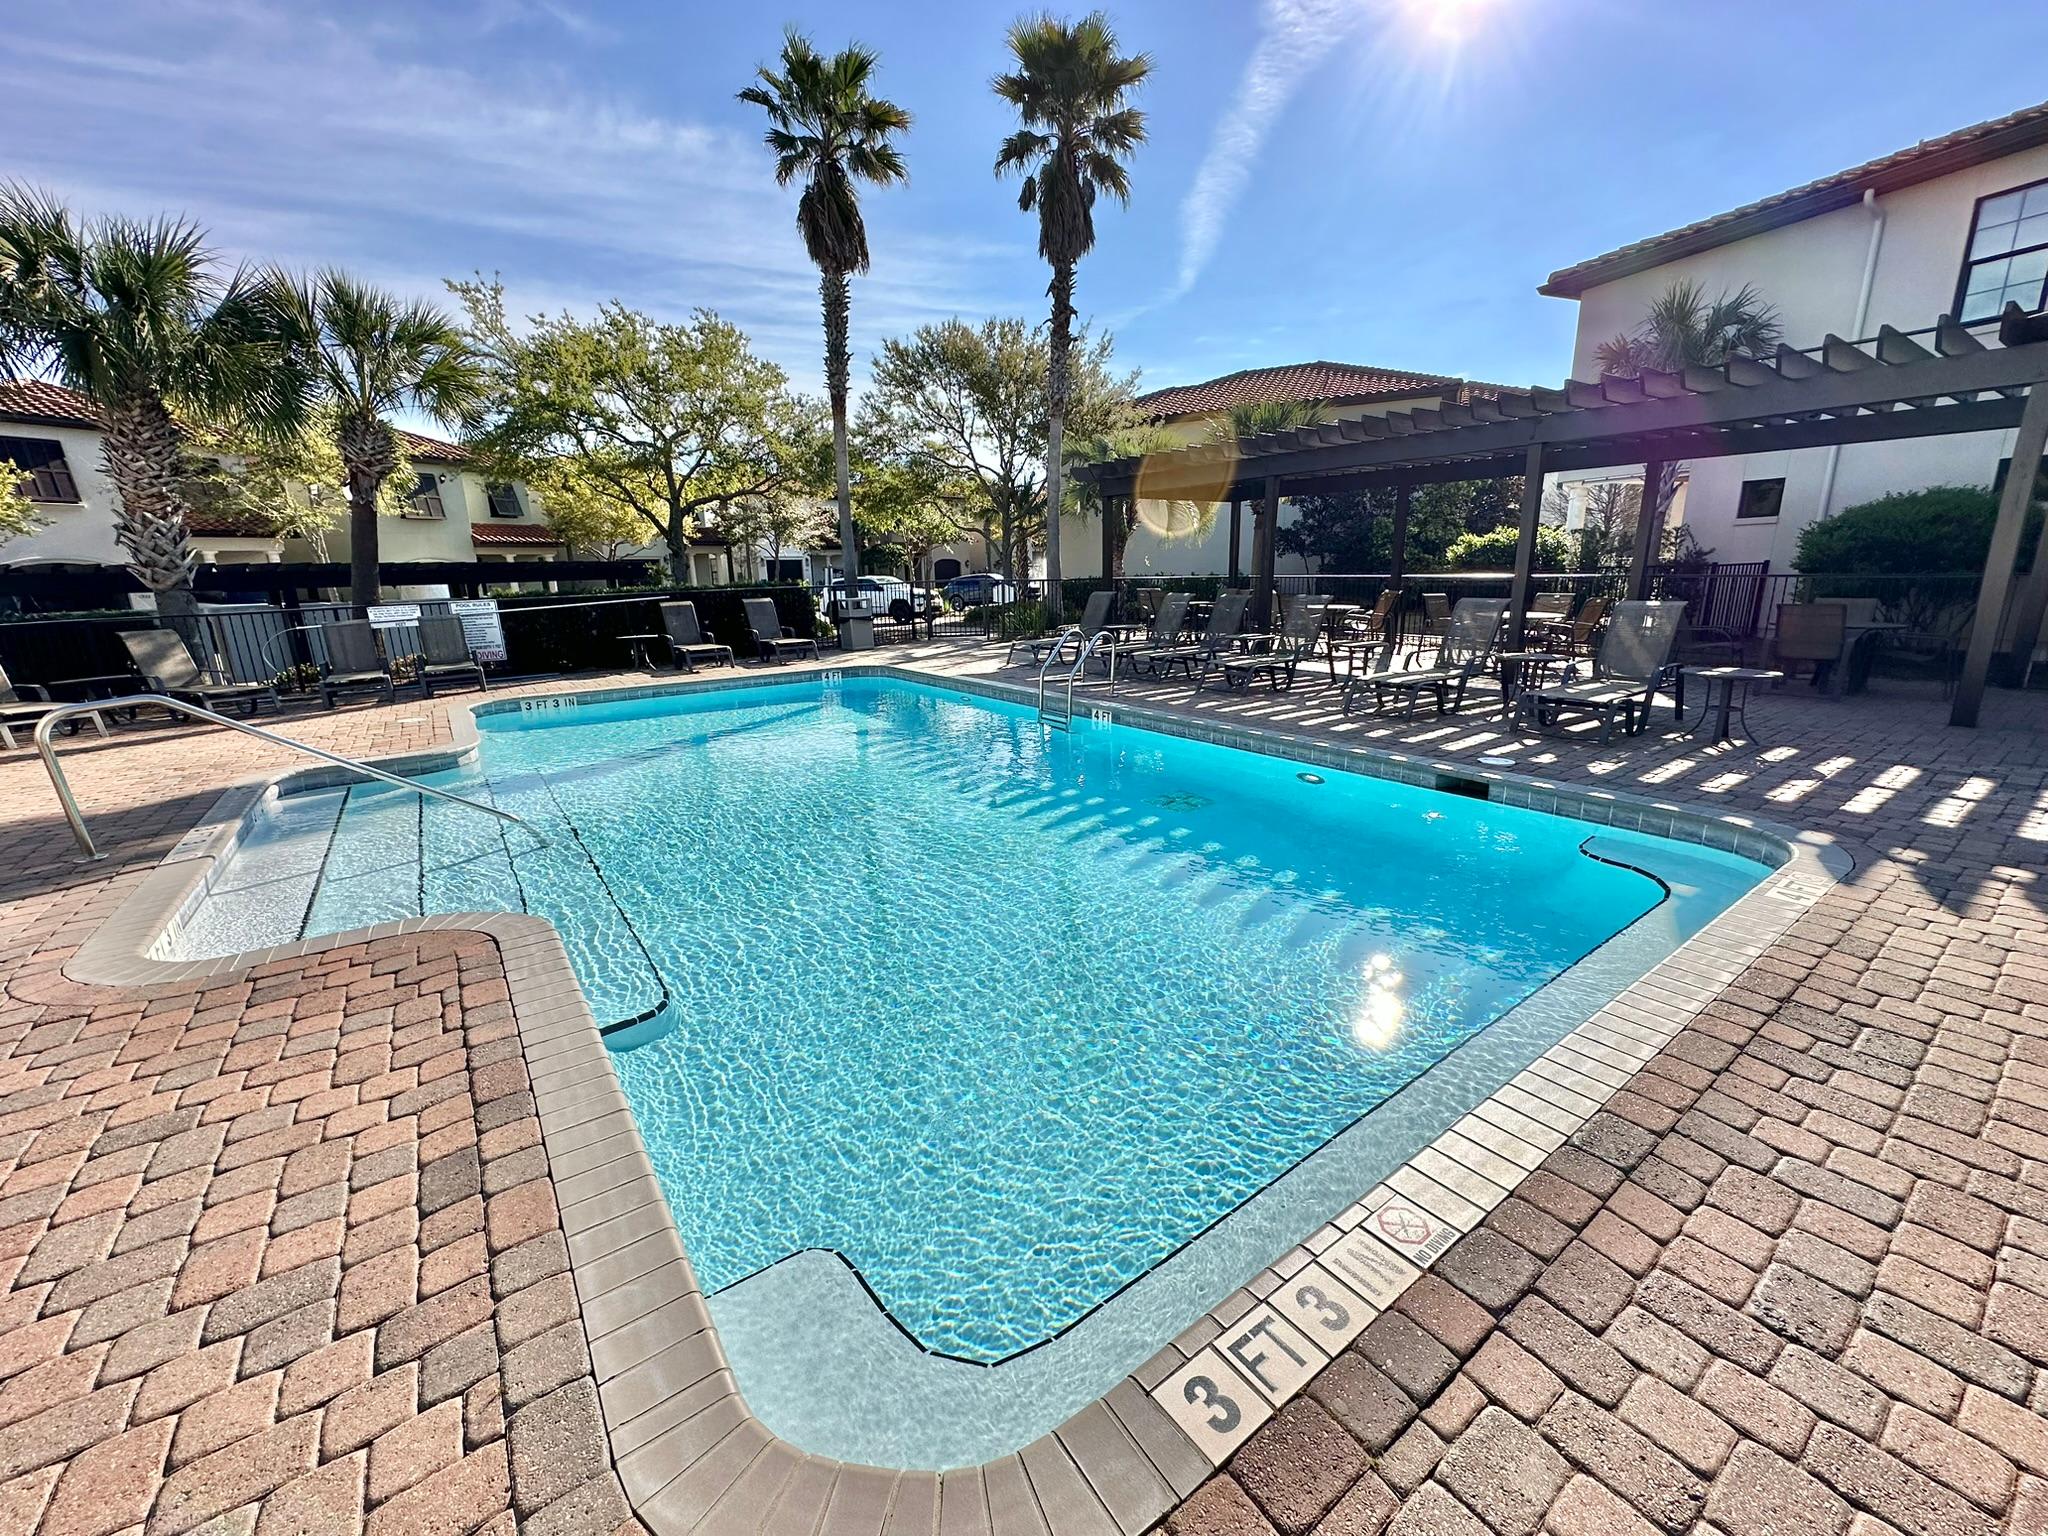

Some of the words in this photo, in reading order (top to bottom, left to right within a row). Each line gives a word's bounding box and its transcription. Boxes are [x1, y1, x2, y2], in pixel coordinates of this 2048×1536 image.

[824, 672, 830, 680] 4
[832, 671, 840, 680] FT
[525, 701, 532, 711] 3
[536, 699, 548, 710] FT
[552, 698, 560, 708] 3
[564, 698, 575, 707] IN
[1094, 710, 1099, 720] 4
[1102, 711, 1111, 722] FT
[1783, 880, 1821, 895] FT
[1776, 891, 1811, 901] 4
[1413, 1249, 1433, 1265] NO
[1428, 1227, 1456, 1253] DIVING
[1184, 1374, 1242, 1434] 3
[1227, 1314, 1308, 1394] FT
[1295, 1285, 1351, 1332] 3
